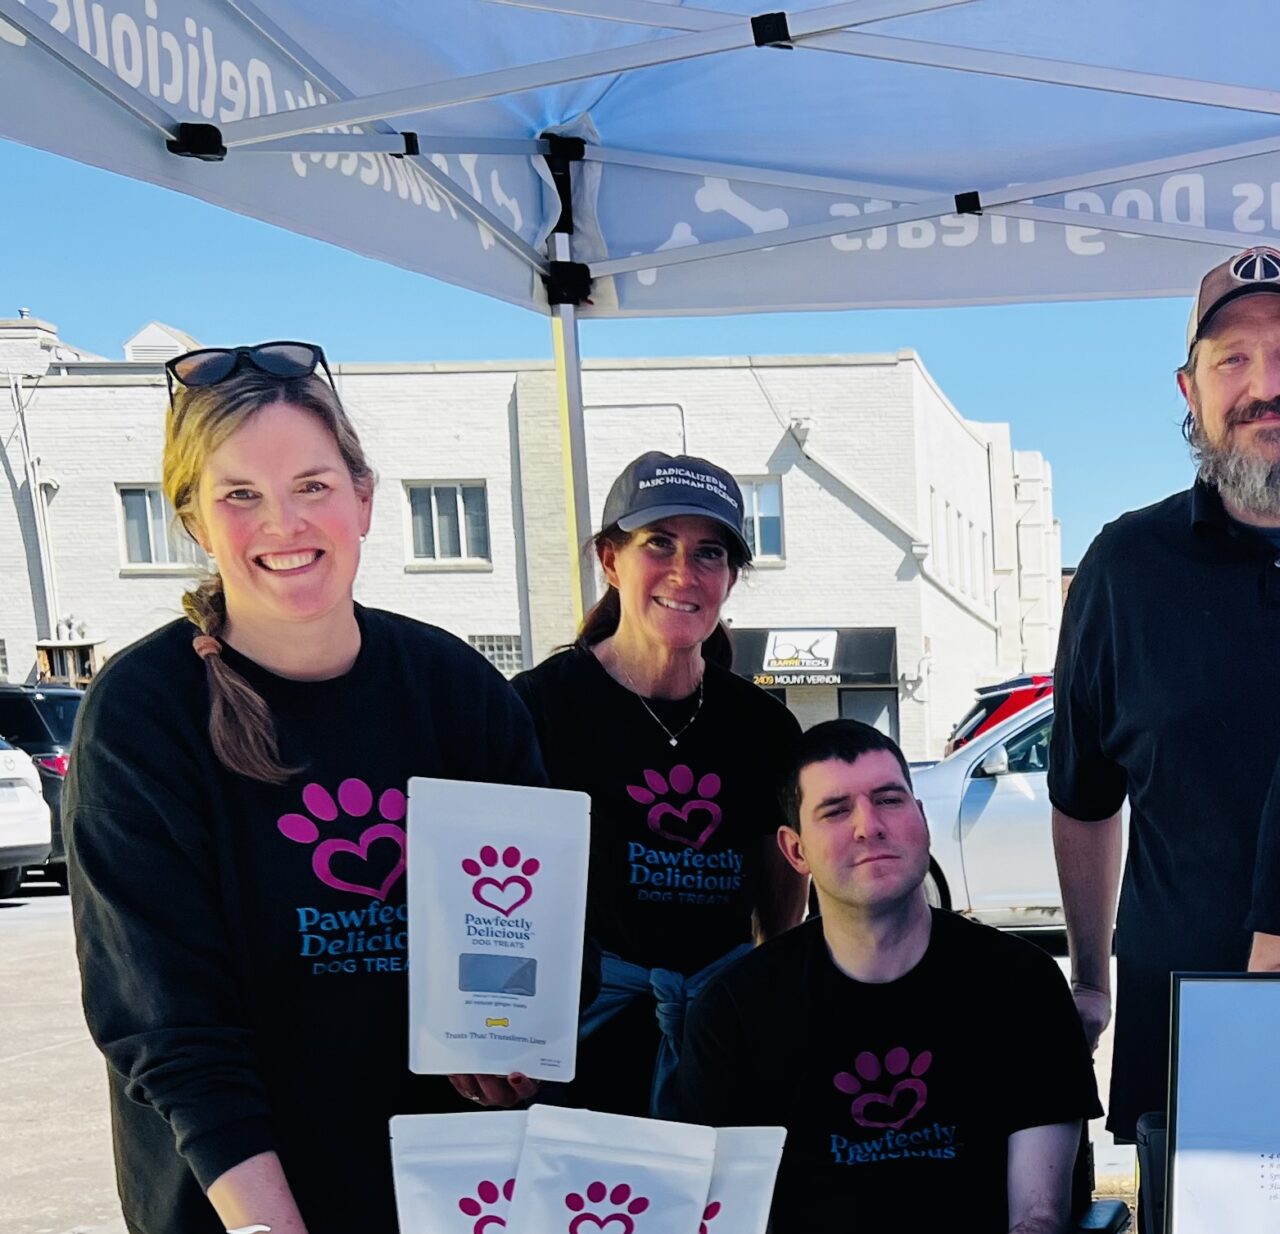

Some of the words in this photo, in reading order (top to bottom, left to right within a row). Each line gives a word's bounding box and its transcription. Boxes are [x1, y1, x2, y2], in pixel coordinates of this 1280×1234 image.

[639, 477, 665, 490] BASIC
[665, 476, 705, 490] HUMAN
[656, 467, 719, 485] RADICALIZED
[774, 674, 805, 685] MOUNT
[805, 674, 841, 685] VERNON
[627, 841, 744, 873] Pawfectly
[628, 864, 742, 890] Delicious
[637, 889, 673, 902] DOG
[464, 913, 533, 932] Pawfectly
[466, 925, 531, 941] Delicious
[471, 938, 492, 947] DOG
[494, 939, 525, 949] TREATS
[312, 960, 358, 975] DOG
[830, 1121, 957, 1155] Pawfectly
